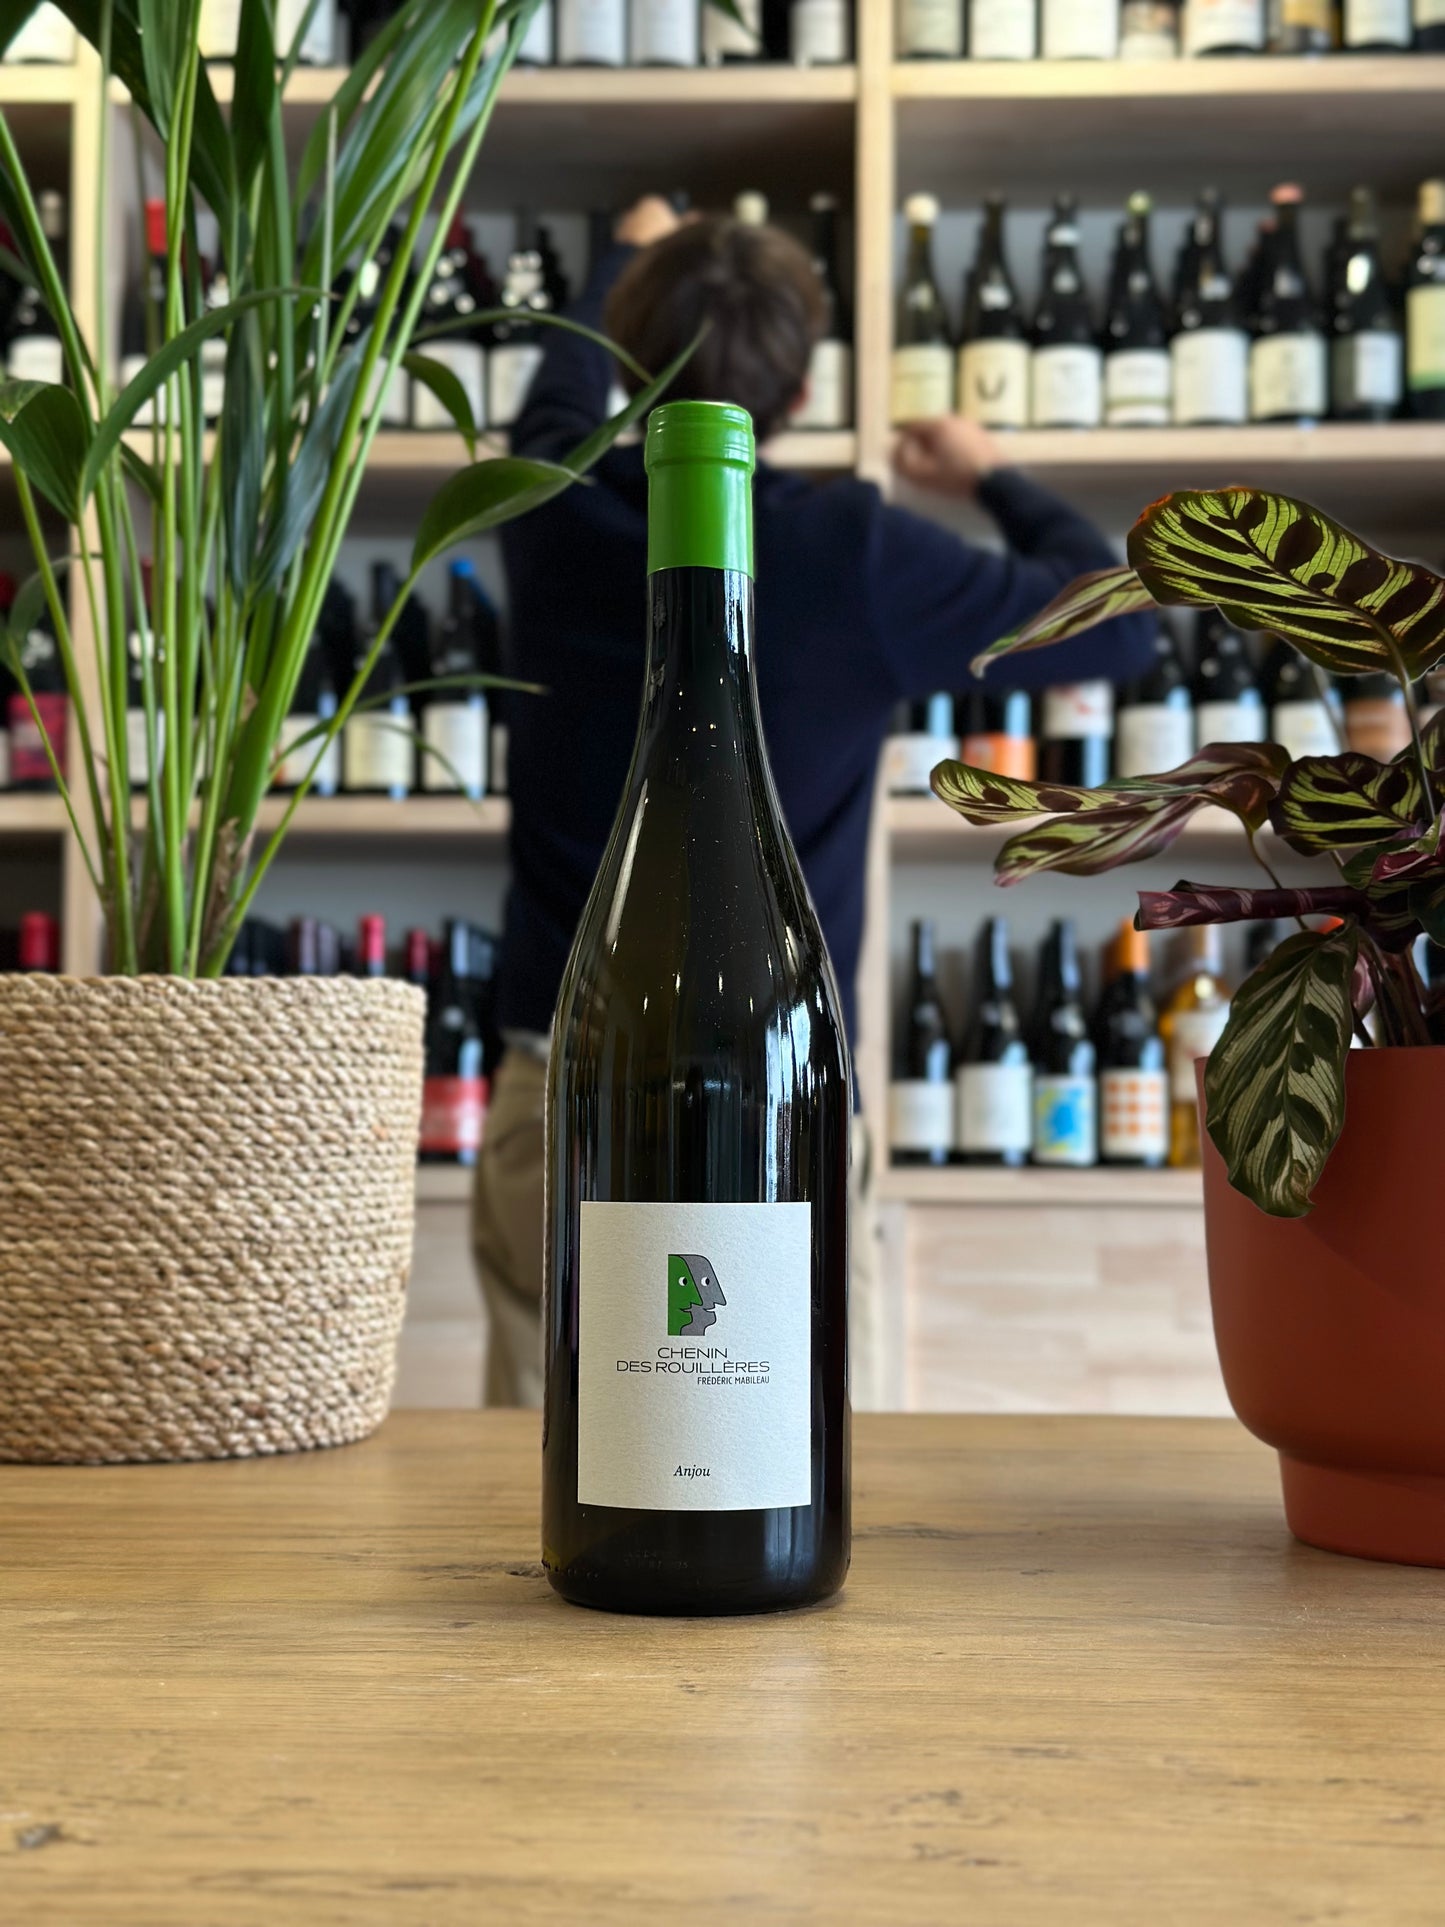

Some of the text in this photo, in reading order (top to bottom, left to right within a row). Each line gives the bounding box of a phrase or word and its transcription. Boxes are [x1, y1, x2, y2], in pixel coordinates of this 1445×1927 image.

[657, 1347, 728, 1359] CHENIN
[616, 1360, 770, 1374] DES ROUILLÈRES
[697, 1375, 770, 1386] FRÉDÉRIC MABILEAU
[673, 1464, 711, 1480] Anjou
